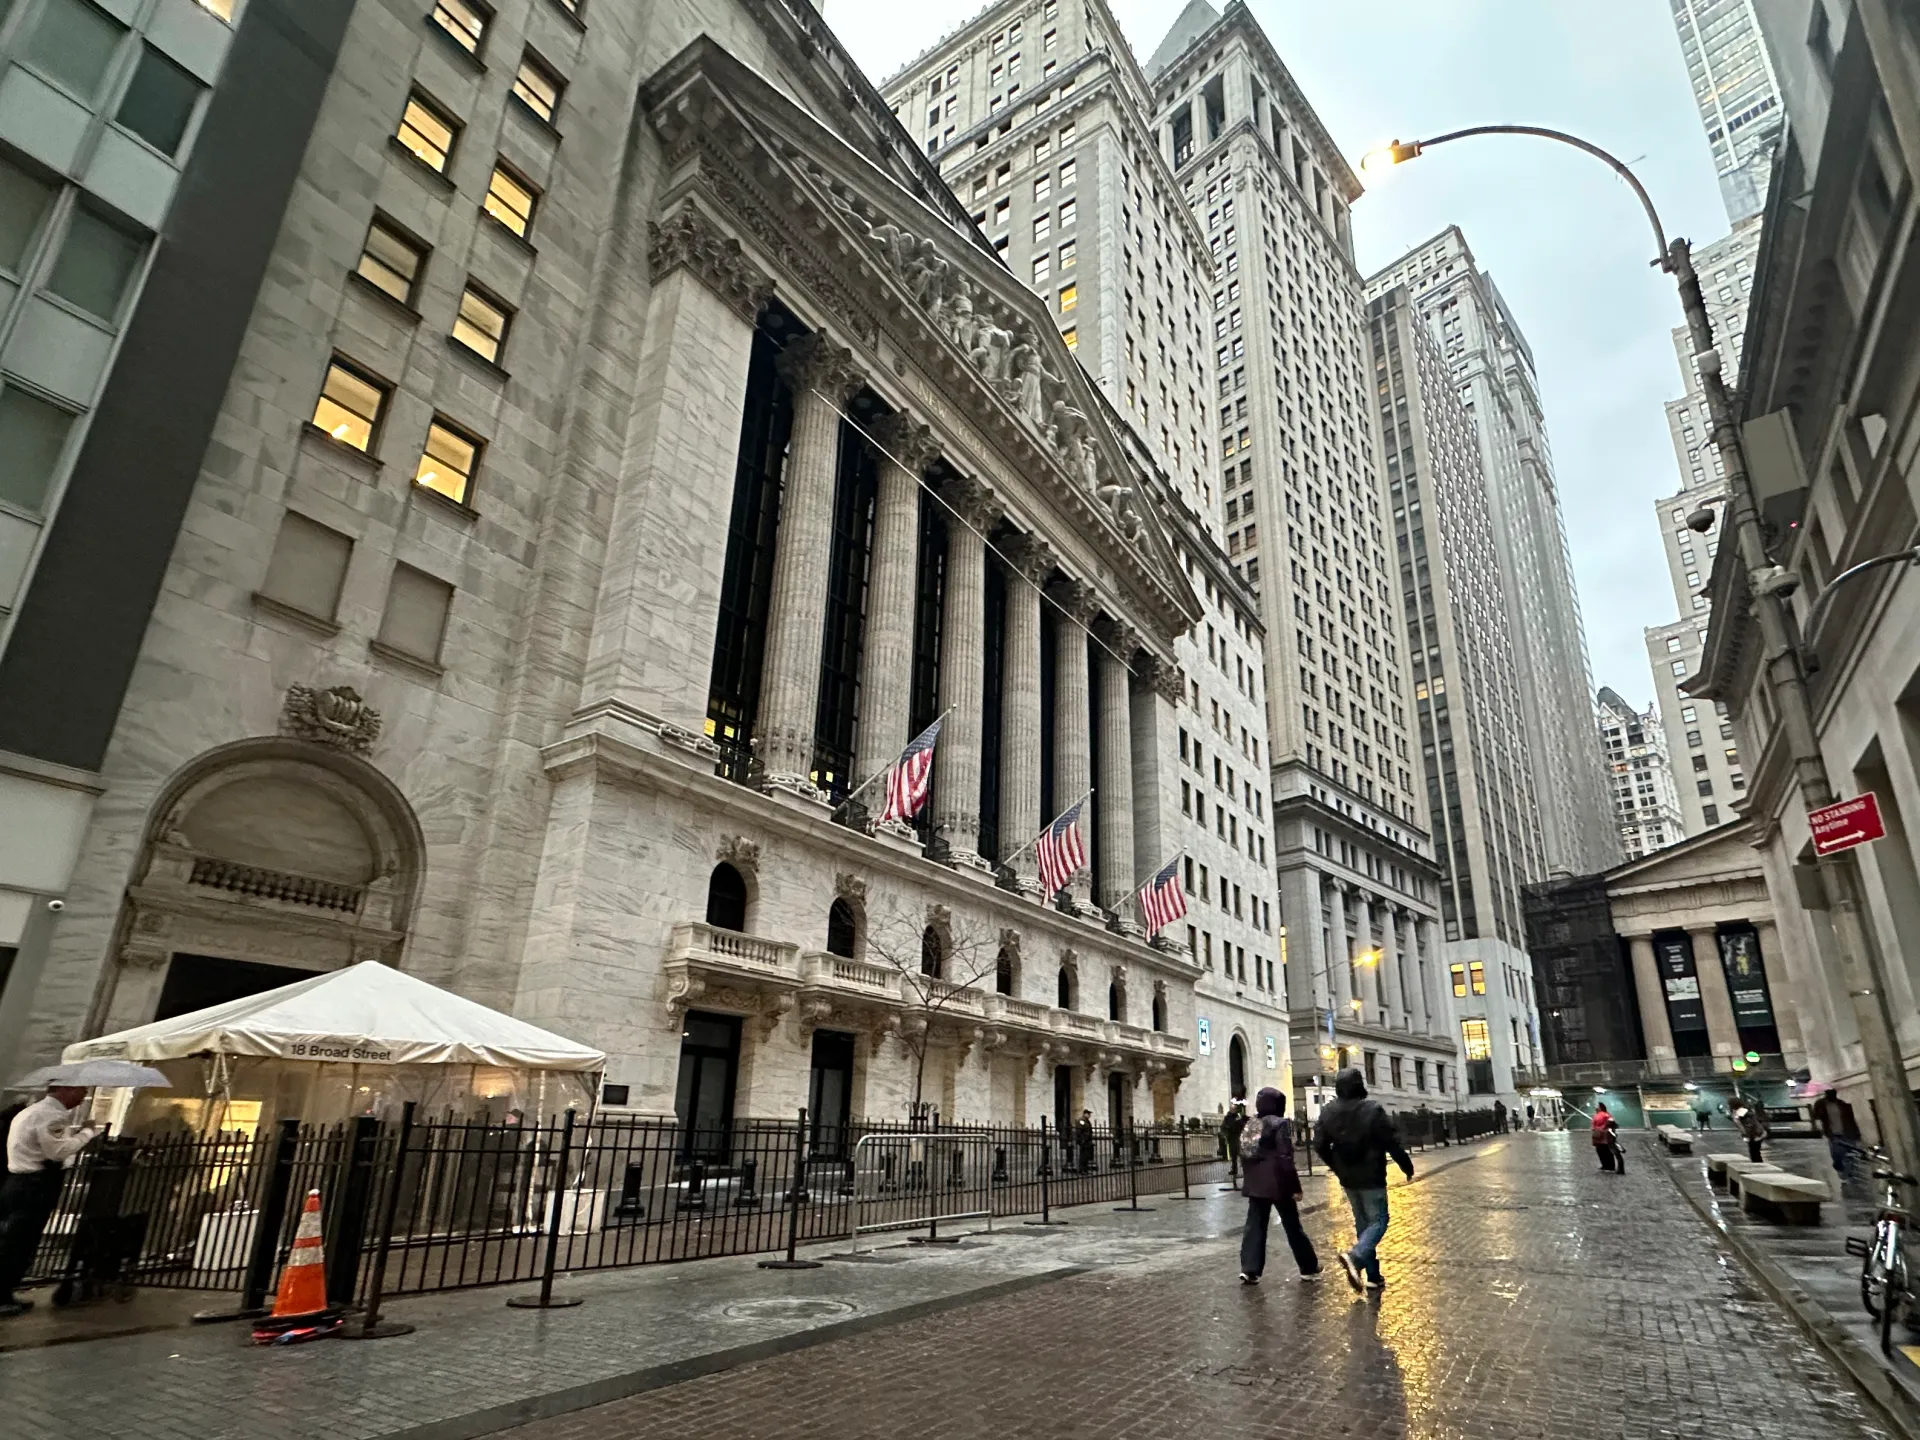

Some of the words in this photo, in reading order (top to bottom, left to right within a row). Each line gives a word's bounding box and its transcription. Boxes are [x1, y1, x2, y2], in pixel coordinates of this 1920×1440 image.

[917, 379, 948, 419] NEW
[1811, 815, 1824, 825] NO
[1824, 800, 1866, 820] STANDING
[291, 1044, 306, 1056] 18
[309, 1045, 350, 1058] Broad
[352, 1048, 392, 1061] Street
